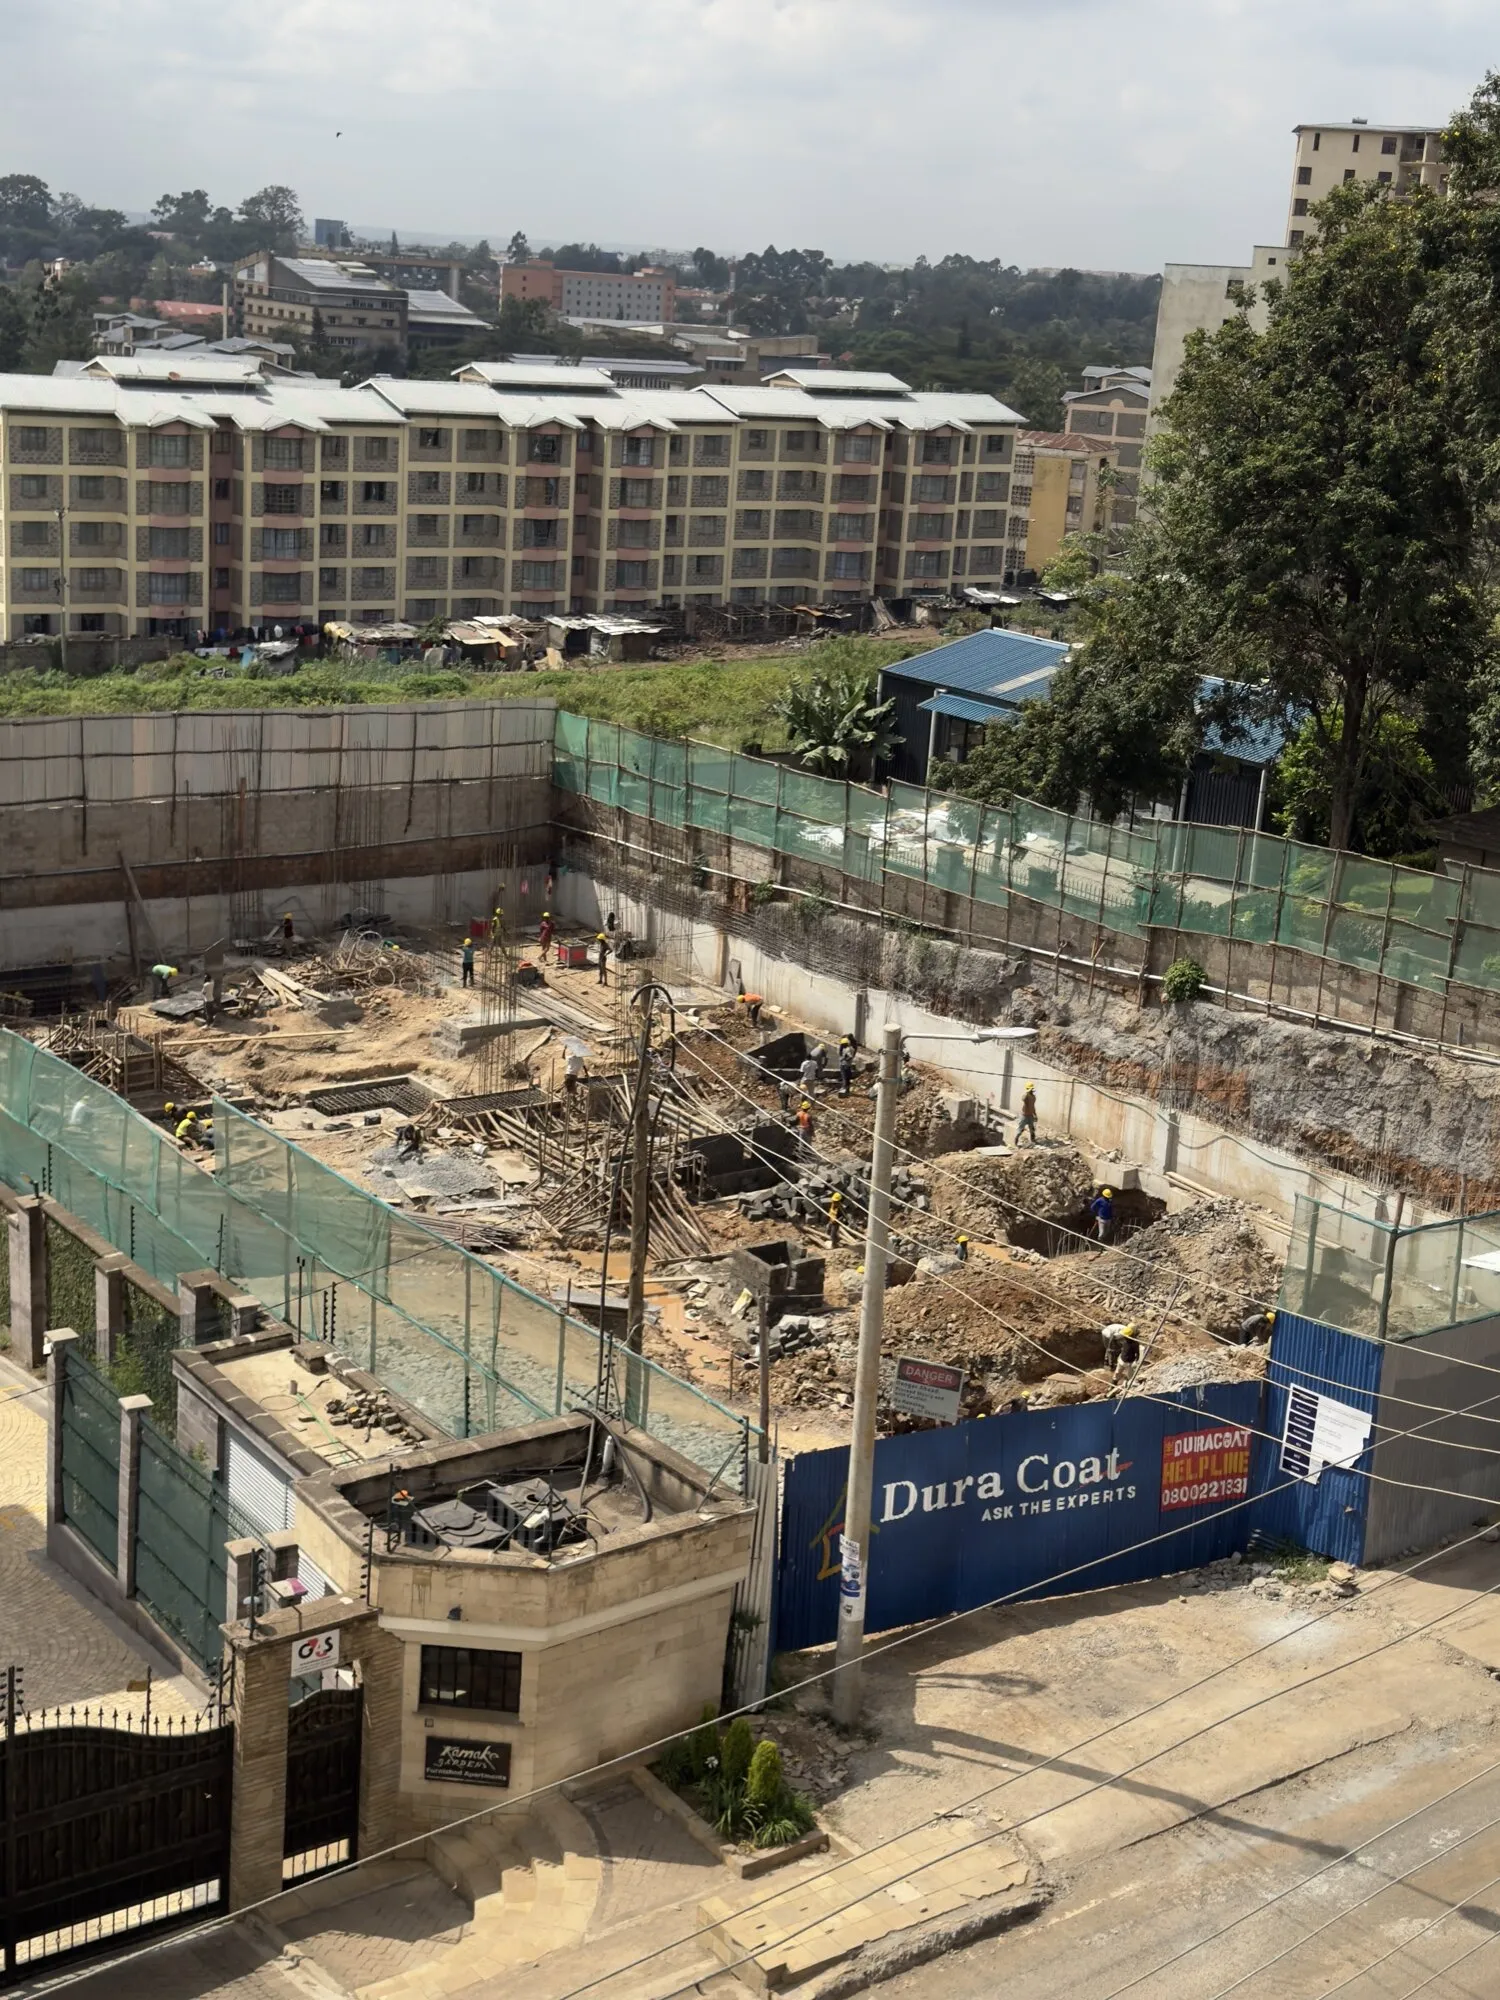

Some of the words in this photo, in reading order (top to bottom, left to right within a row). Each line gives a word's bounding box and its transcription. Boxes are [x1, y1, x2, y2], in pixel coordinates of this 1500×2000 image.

[905, 1366, 953, 1384] DANGER
[1174, 1430, 1251, 1457] DURACOAT
[1162, 1451, 1250, 1485] HELPLINE
[880, 1471, 1004, 1523] Dura
[1016, 1447, 1121, 1493] Coat
[1161, 1477, 1248, 1506] 0800221331
[981, 1505, 1014, 1522] ASK
[1020, 1499, 1051, 1516] THE
[1056, 1485, 1137, 1511] EXPERTS
[298, 1636, 334, 1659] G4S
